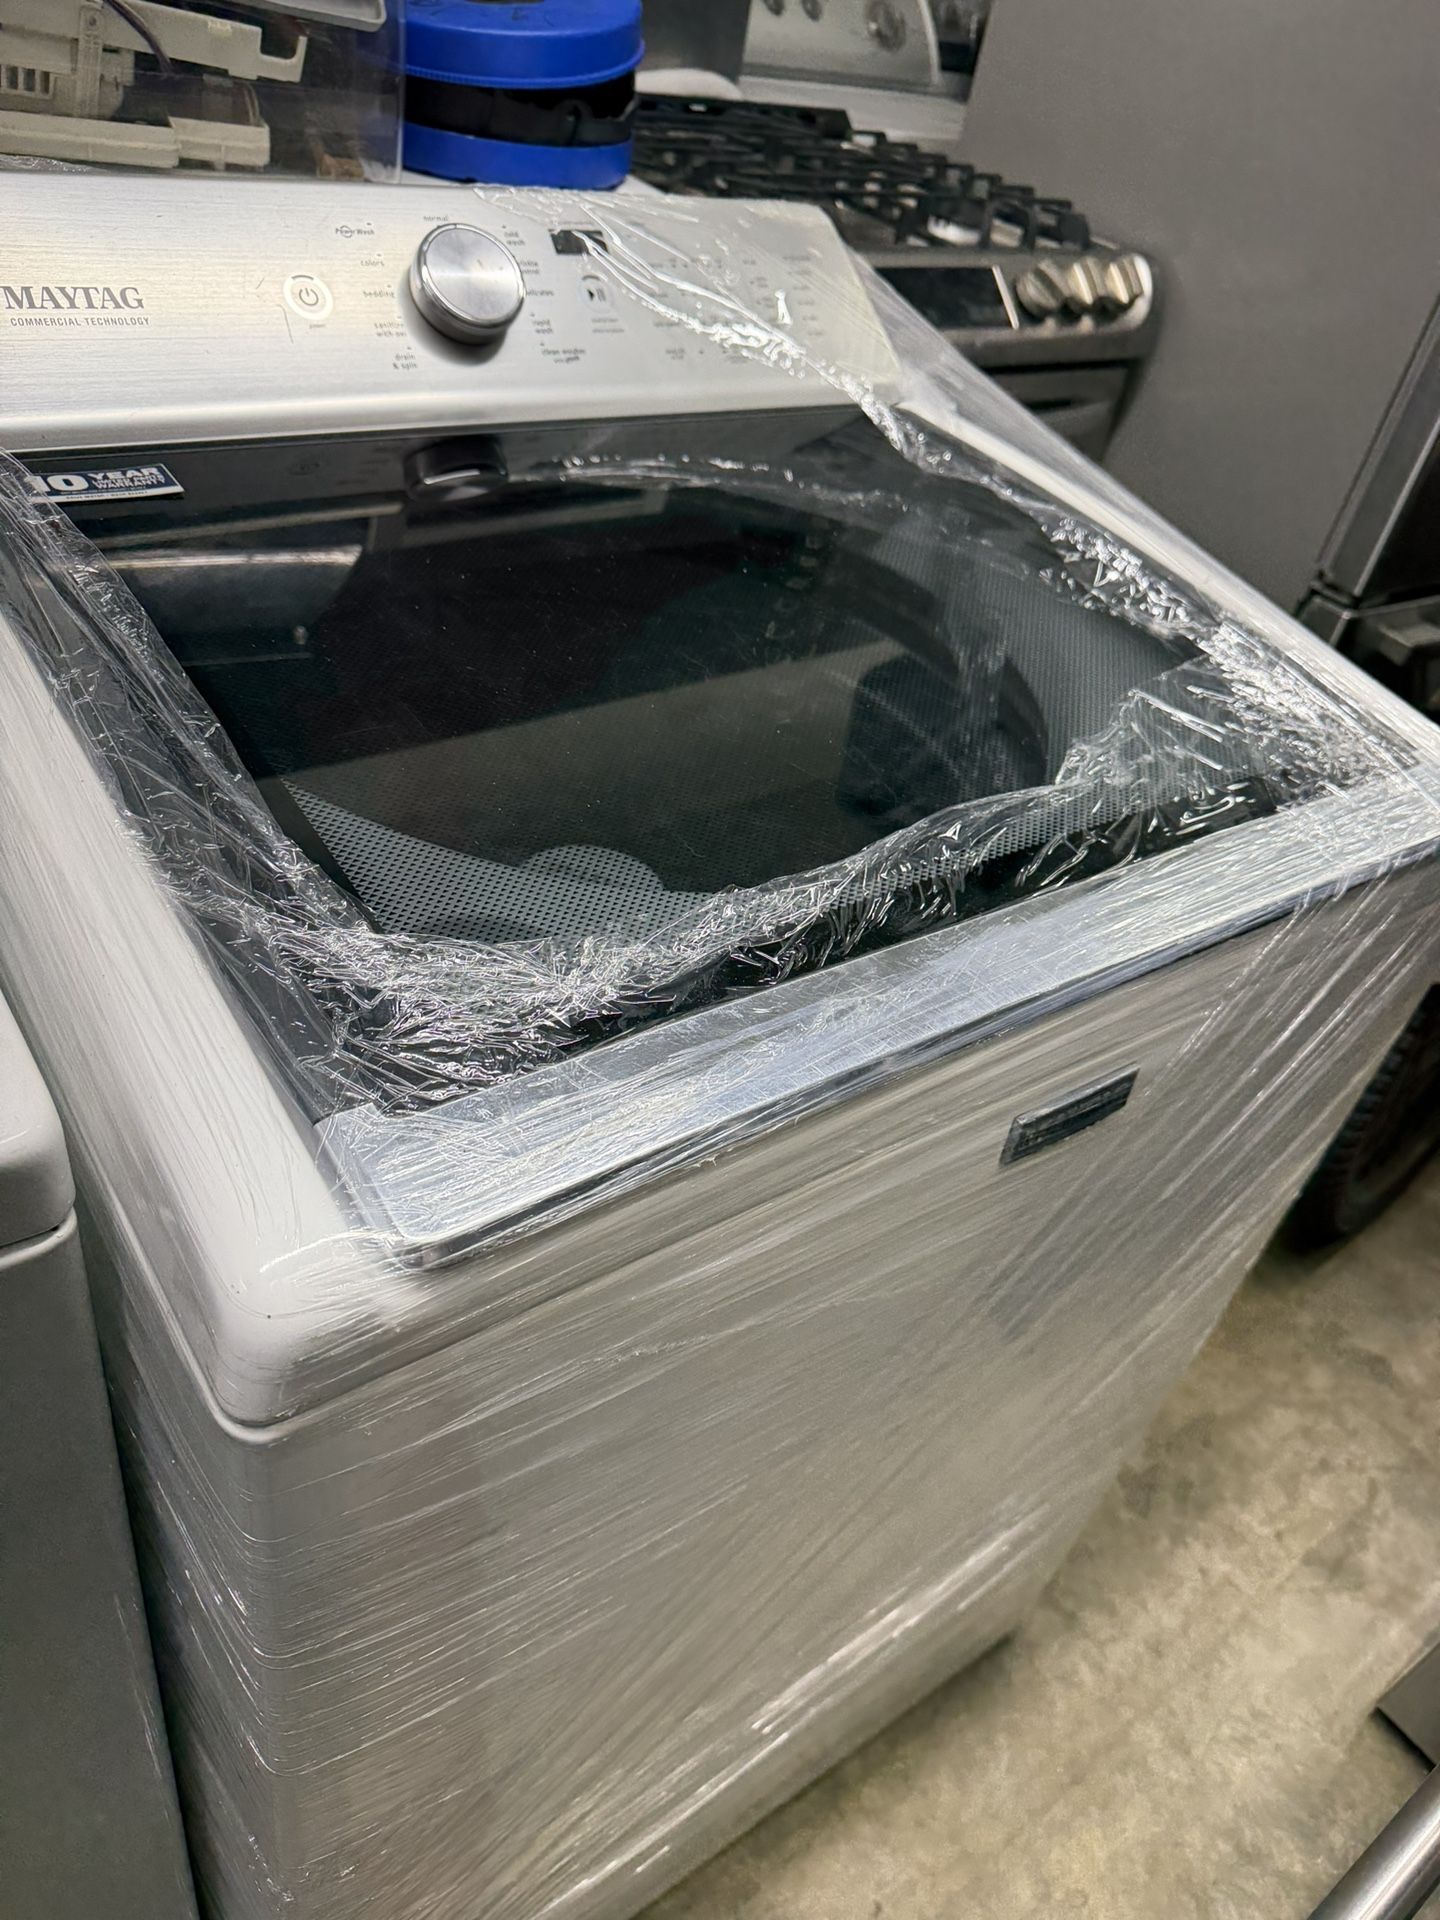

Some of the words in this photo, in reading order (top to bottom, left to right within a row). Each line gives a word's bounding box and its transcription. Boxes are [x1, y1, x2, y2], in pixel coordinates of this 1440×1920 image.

[0, 285, 145, 310] MAYTAG
[10, 316, 82, 326] COMMERCIAL
[84, 316, 151, 326] TECHNOLOGY
[24, 474, 89, 493] 10
[88, 468, 160, 480] YEAR
